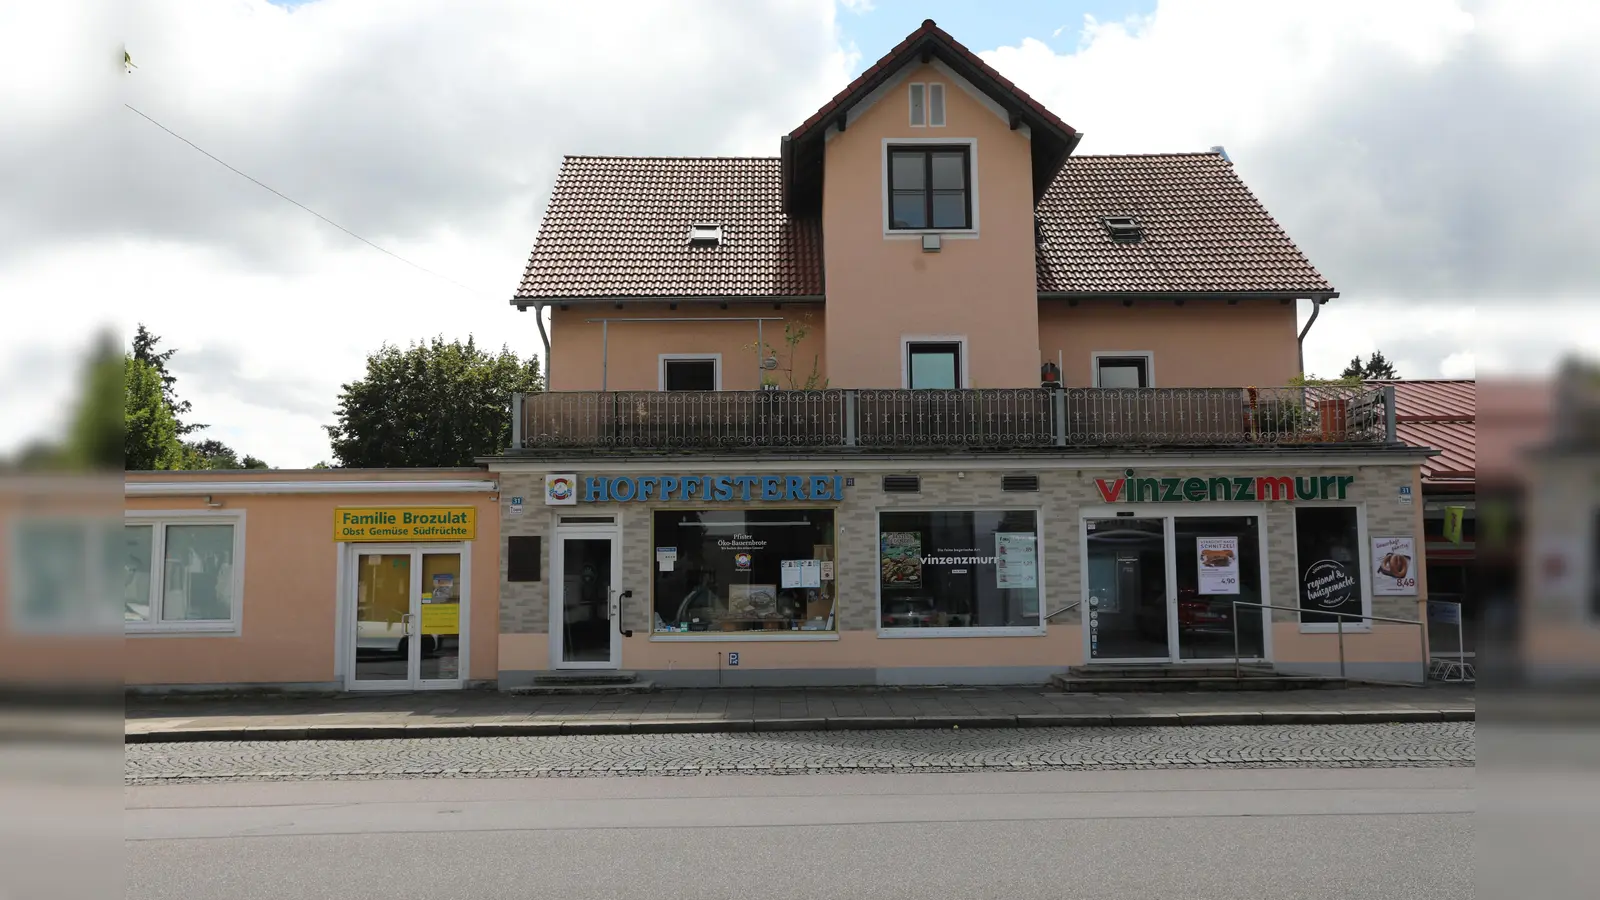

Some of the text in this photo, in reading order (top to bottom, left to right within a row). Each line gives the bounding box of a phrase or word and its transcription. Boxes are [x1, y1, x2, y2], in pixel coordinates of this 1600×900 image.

[585, 475, 844, 502] HOFPFISTEREI
[1094, 468, 1354, 502] vinzenzmurr
[343, 511, 467, 524] Familie Brozulat
[342, 526, 467, 535] Obst Gemüse Südfrüchte
[920, 554, 1000, 565] vinzenzmurr
[1307, 570, 1344, 590] regional &
[1307, 575, 1356, 600] hausgemacht
[1396, 578, 1415, 587] 8,49
